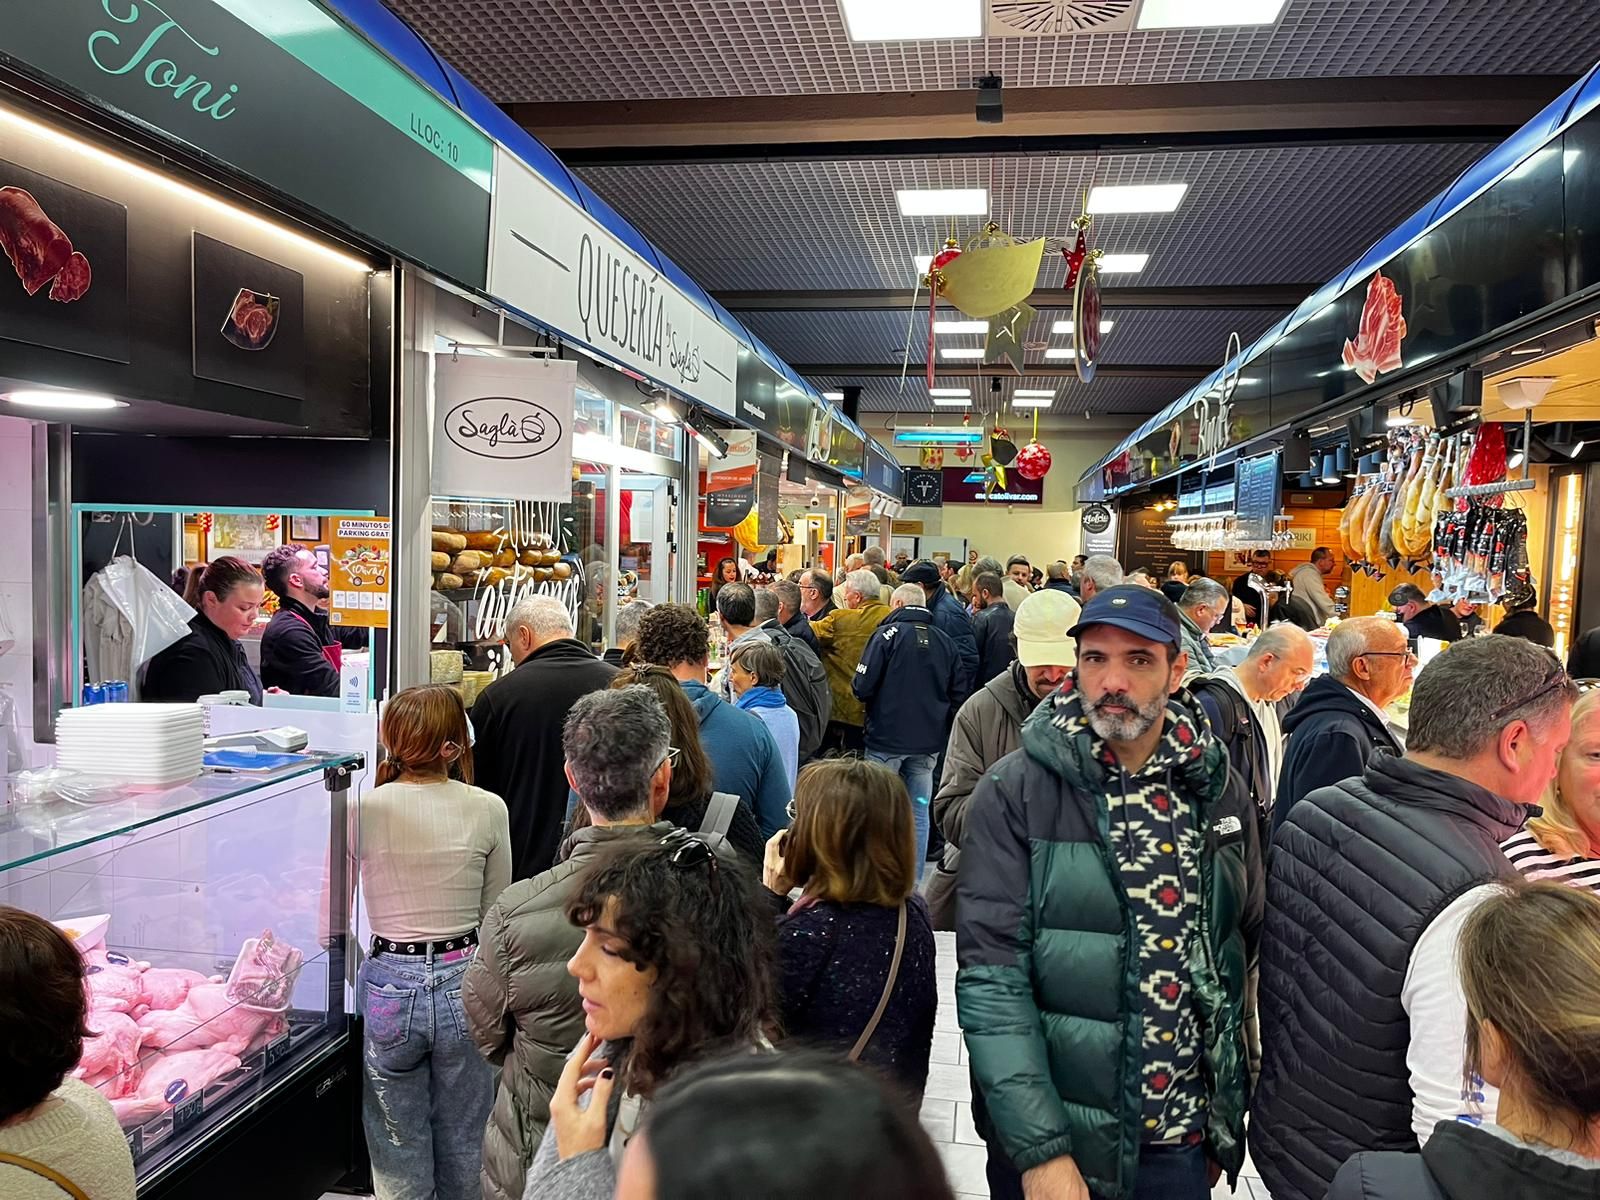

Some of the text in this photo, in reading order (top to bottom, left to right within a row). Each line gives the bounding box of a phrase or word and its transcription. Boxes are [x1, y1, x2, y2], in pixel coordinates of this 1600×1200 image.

[88, 0, 238, 121] Toni
[410, 112, 459, 163] LLOC: 10
[578, 233, 664, 368] QUESERÍA
[458, 409, 519, 448] Saglà
[974, 492, 1038, 501] mecatolivar.com
[352, 521, 382, 529] MINUTOS
